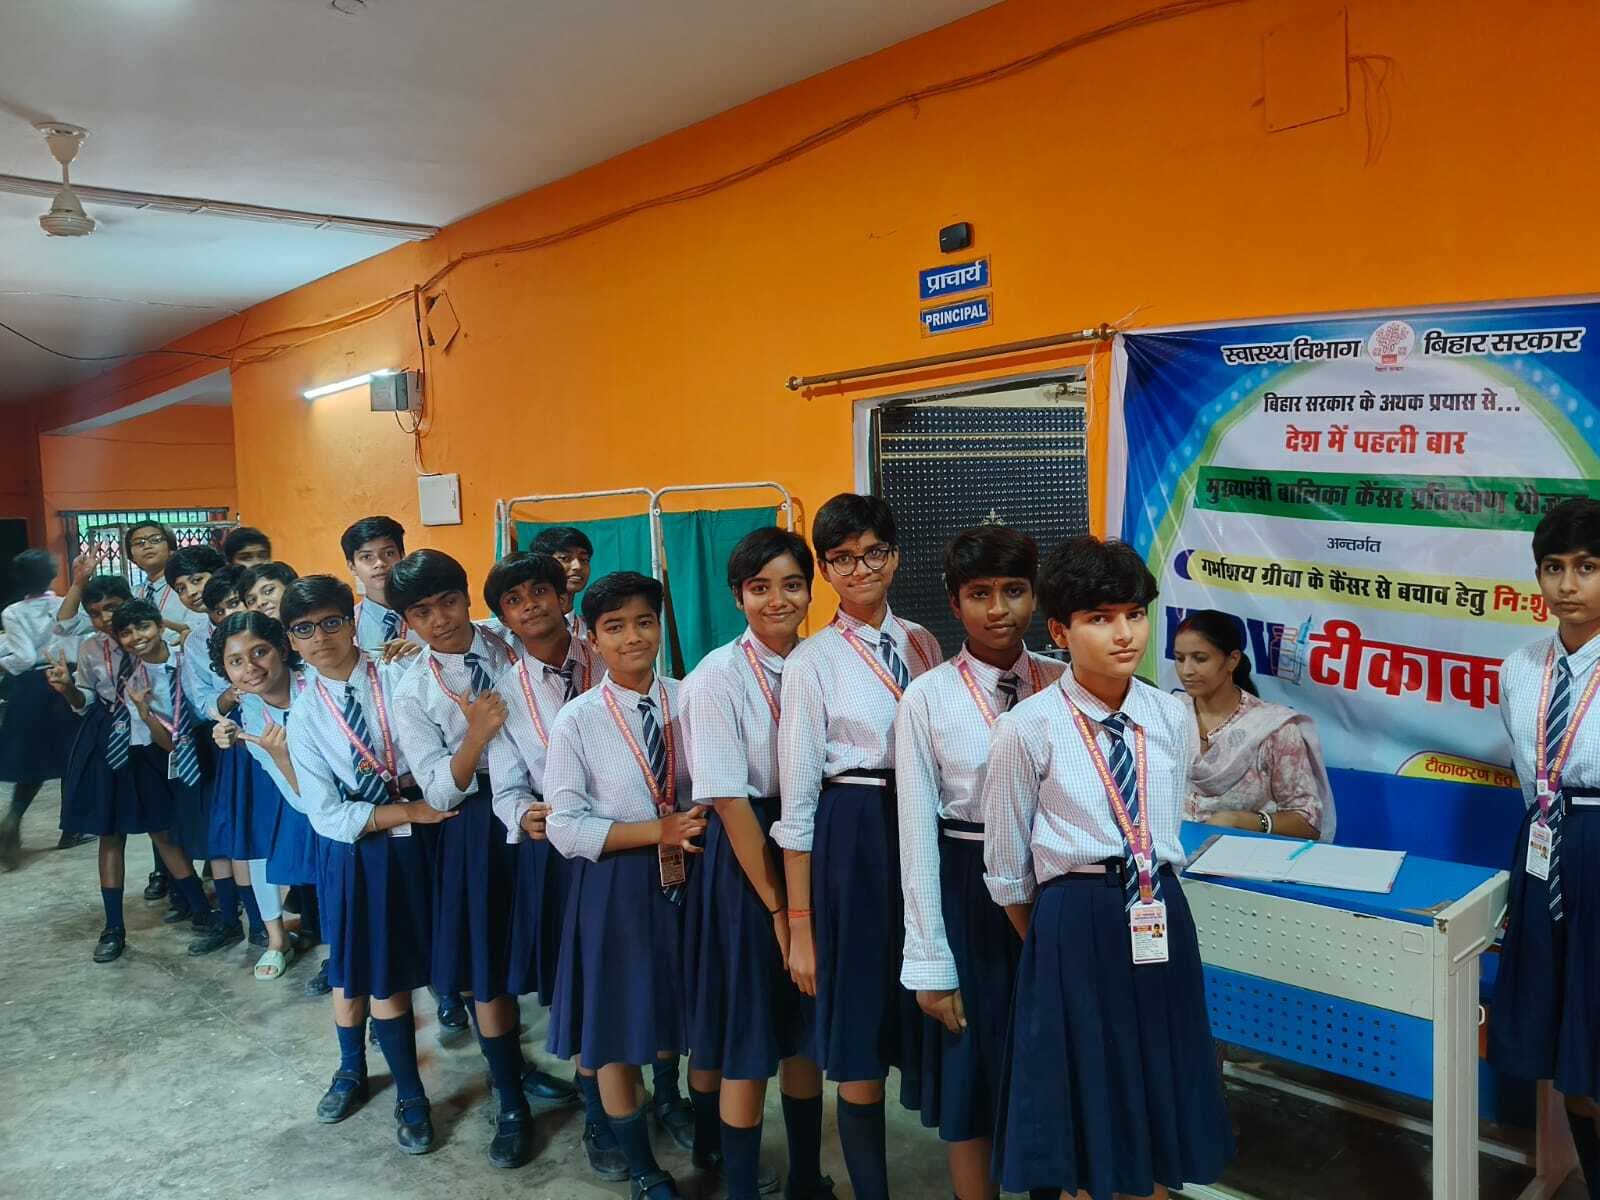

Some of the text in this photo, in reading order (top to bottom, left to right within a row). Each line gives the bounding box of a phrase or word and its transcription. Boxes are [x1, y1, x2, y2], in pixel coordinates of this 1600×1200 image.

[926, 260, 982, 293] प्राचार्य
[925, 304, 986, 326] PRINCIPAL
[1222, 337, 1362, 364] स्वास्थ्य विभाग
[1424, 330, 1582, 354] बिहार सरकार
[1264, 392, 1302, 412] बिहार
[1305, 395, 1355, 412] सरकार
[1359, 390, 1376, 412] के
[1429, 393, 1477, 412] प्रयास
[1285, 424, 1468, 454] देश में पहली बार
[1206, 476, 1272, 504] मुख्यमंत्री
[1277, 478, 1349, 506] बालिका
[1355, 480, 1406, 509] कैंसर
[1326, 536, 1382, 554] अन्तर्गत
[1201, 556, 1258, 583] गर्भाशय
[1261, 563, 1303, 588] ग्रीवा
[1308, 567, 1325, 590] के
[1329, 569, 1371, 597] कैंसर
[1375, 575, 1392, 600] से
[1397, 582, 1450, 605] बचाव
[1455, 581, 1488, 616] हेतु
[1309, 619, 1505, 710] टीकाक
[1425, 757, 1489, 782] टीकाकरण
